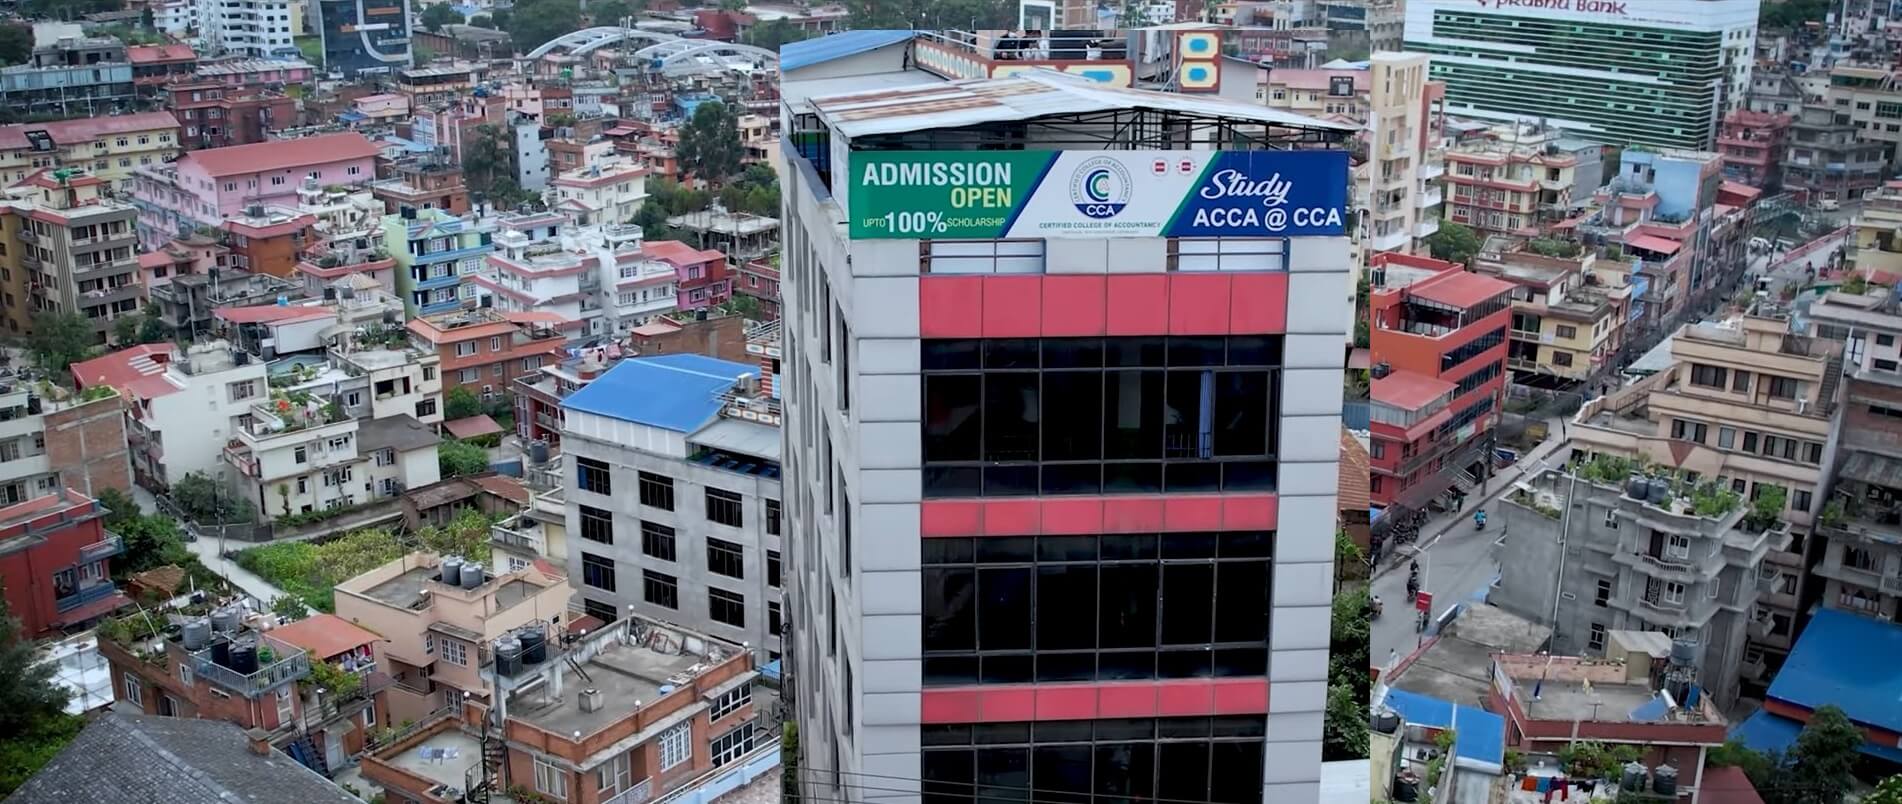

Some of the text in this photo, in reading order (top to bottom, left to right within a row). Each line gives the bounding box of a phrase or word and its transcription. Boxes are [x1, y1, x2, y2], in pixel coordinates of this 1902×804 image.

[862, 162, 1011, 186] ADMISSION
[951, 187, 1011, 208] OPEN
[1200, 169, 1292, 207] Study
[1086, 204, 1115, 216] CCA
[1193, 207, 1342, 232] ACCA @ CCA
[863, 211, 1006, 233] UPTO 100% SCHOLARSHIP
